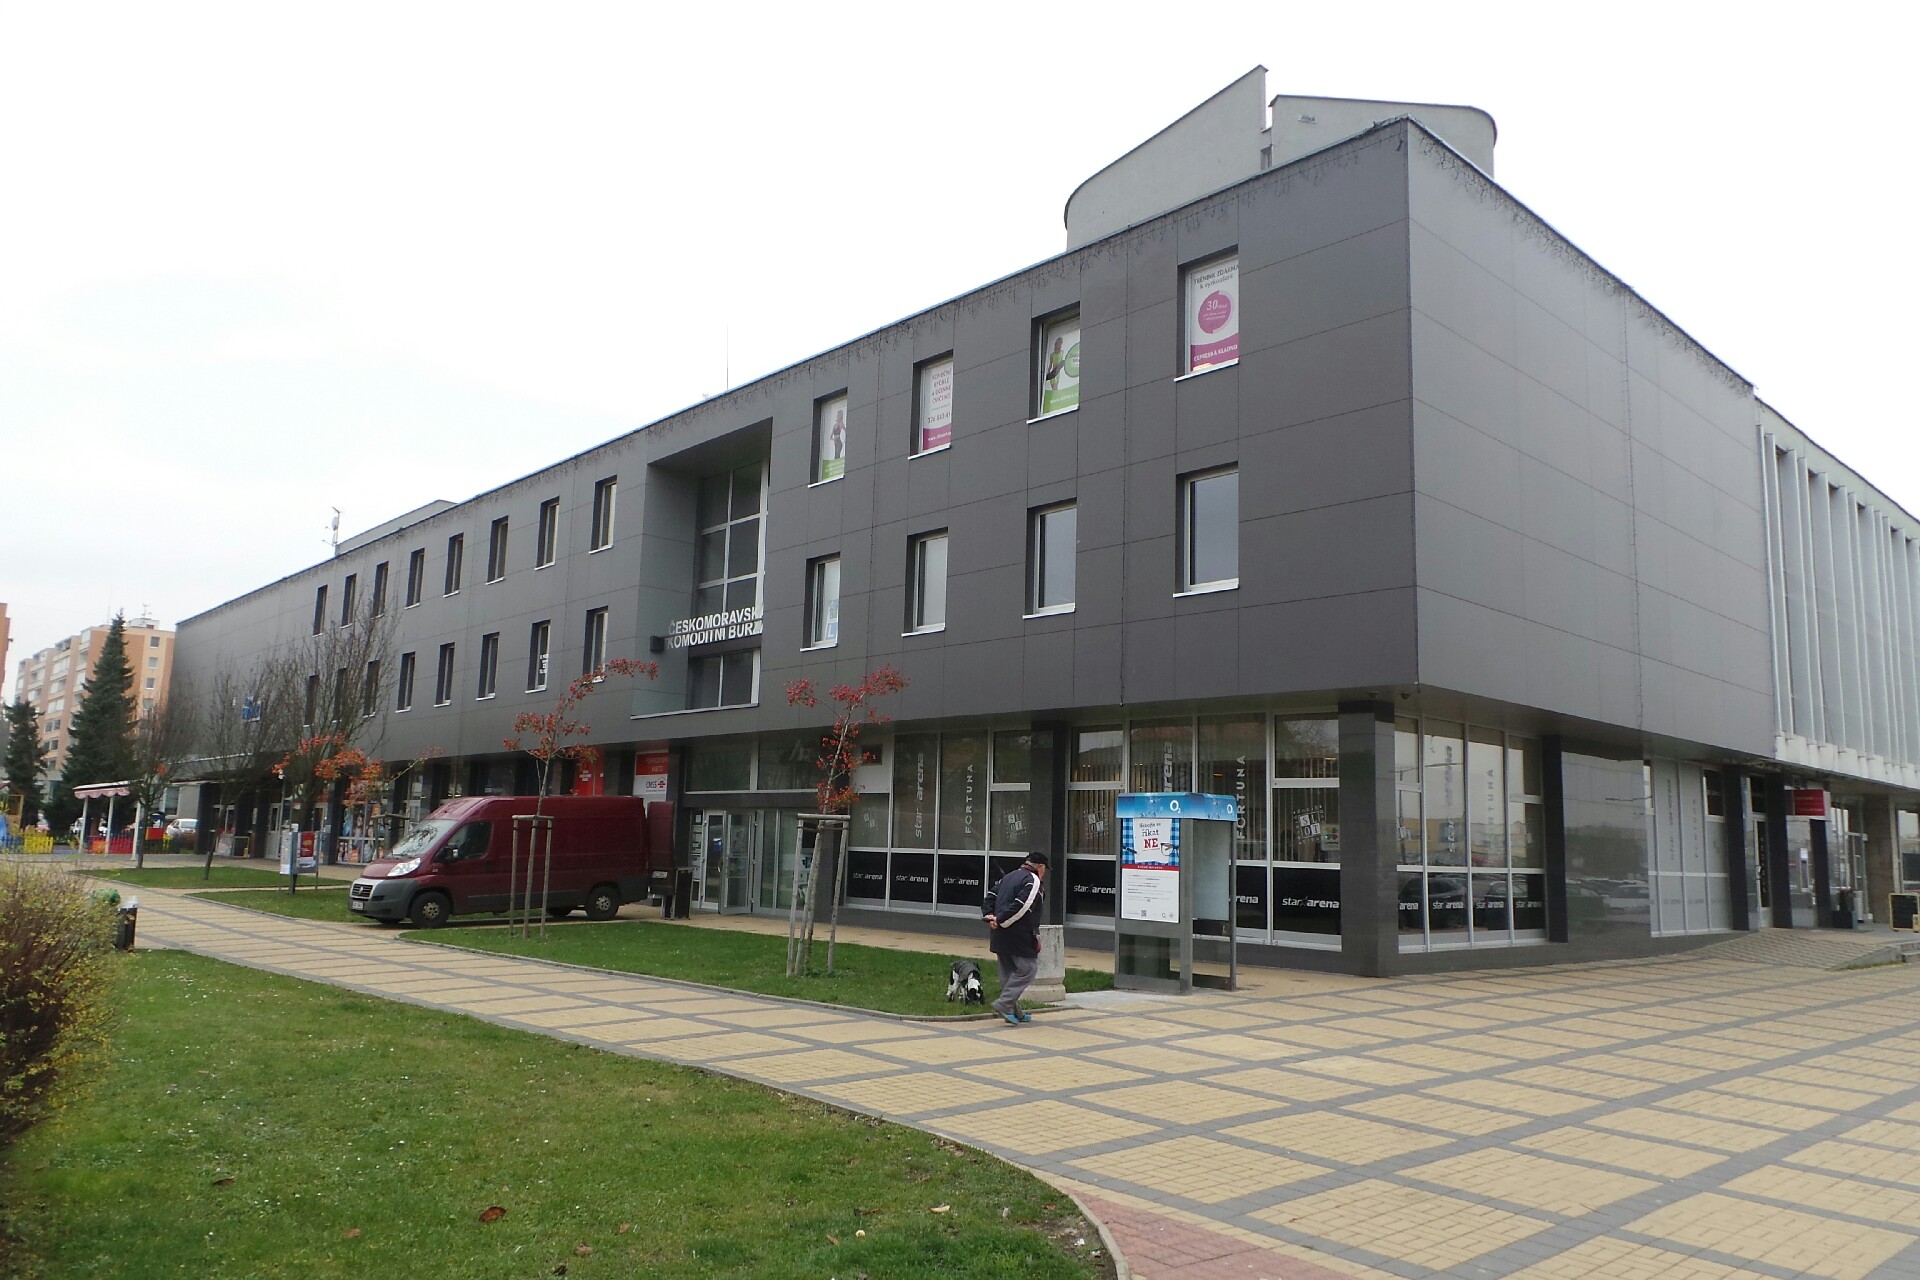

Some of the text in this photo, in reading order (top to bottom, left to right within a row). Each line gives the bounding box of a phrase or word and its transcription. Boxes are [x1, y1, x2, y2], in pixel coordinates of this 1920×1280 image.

[1206, 300, 1218, 310] 30
[965, 764, 974, 834] FORTUNA
[1236, 755, 1246, 840] FORTUNA
[1144, 838, 1159, 848] NE
[1073, 884, 1088, 893] star
[1235, 895, 1259, 904] rena
[1282, 897, 1340, 909] star arena
[1399, 902, 1419, 910] arena
[1445, 901, 1464, 909] arena
[1487, 901, 1505, 909] arena
